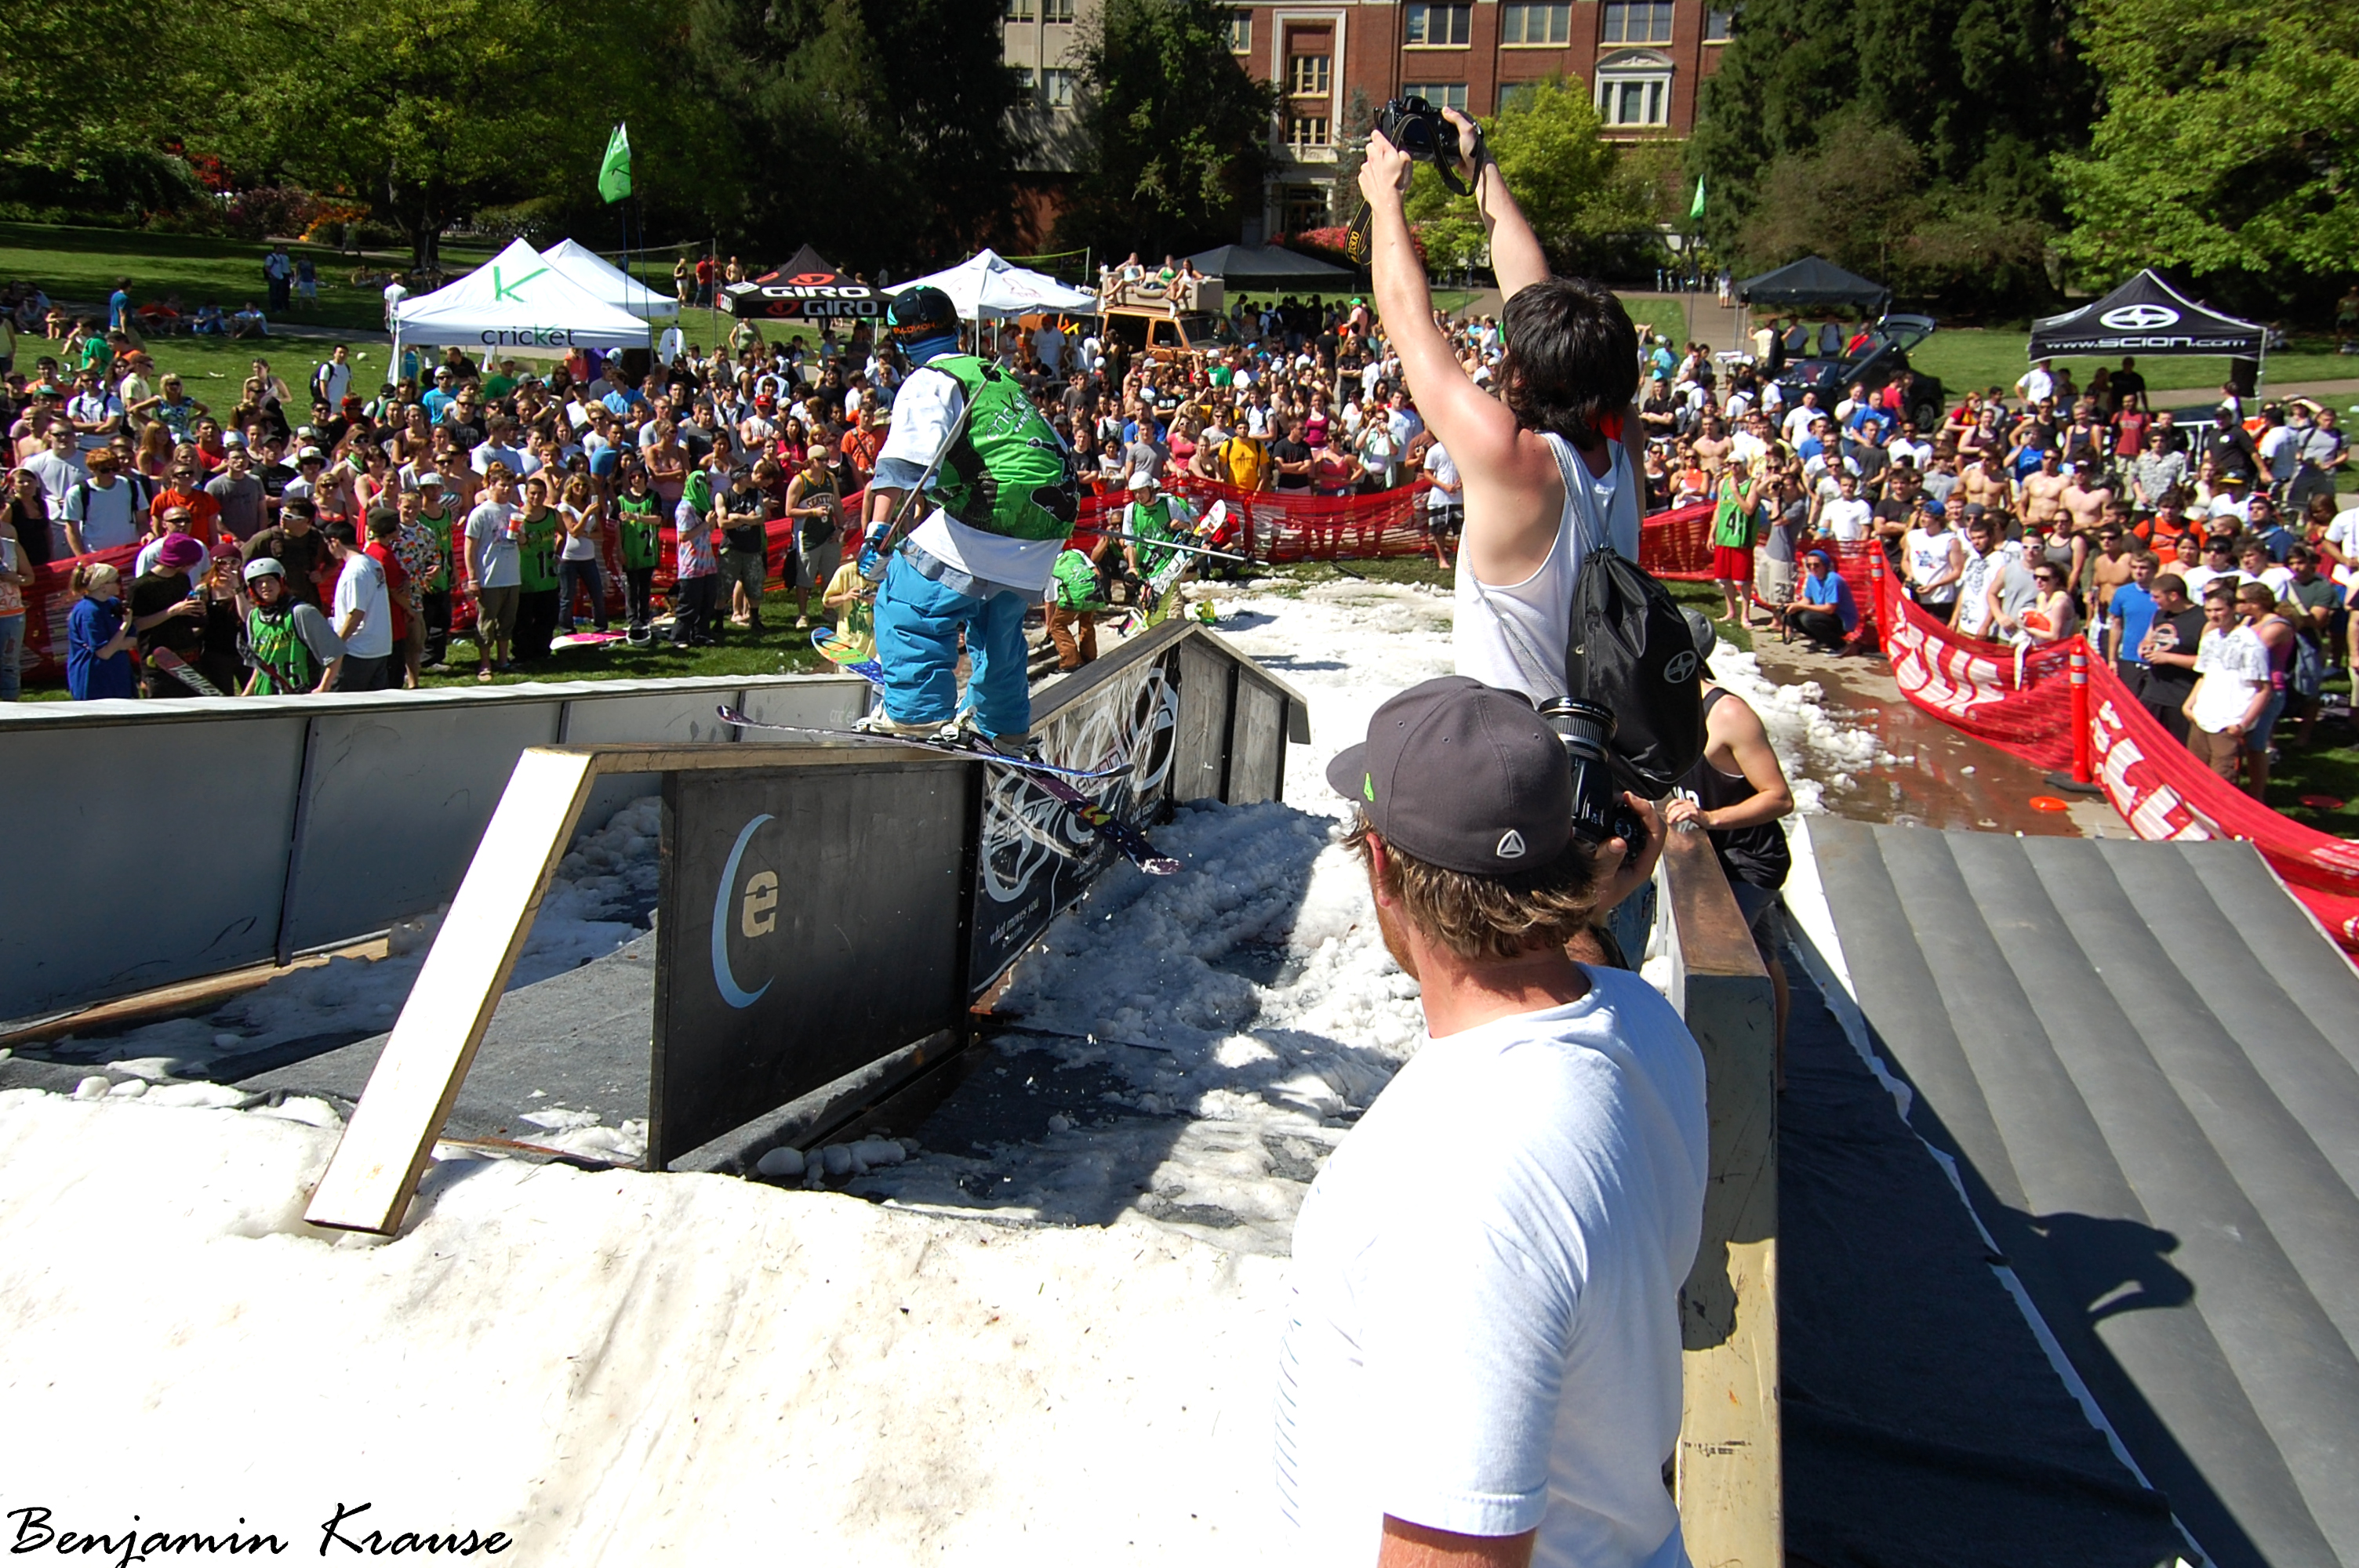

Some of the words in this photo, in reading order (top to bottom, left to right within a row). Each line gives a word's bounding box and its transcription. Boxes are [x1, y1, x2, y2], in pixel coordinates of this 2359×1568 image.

[761, 285, 871, 298] GIRO
[803, 300, 878, 316] GIRO
[481, 323, 576, 346] cricket
